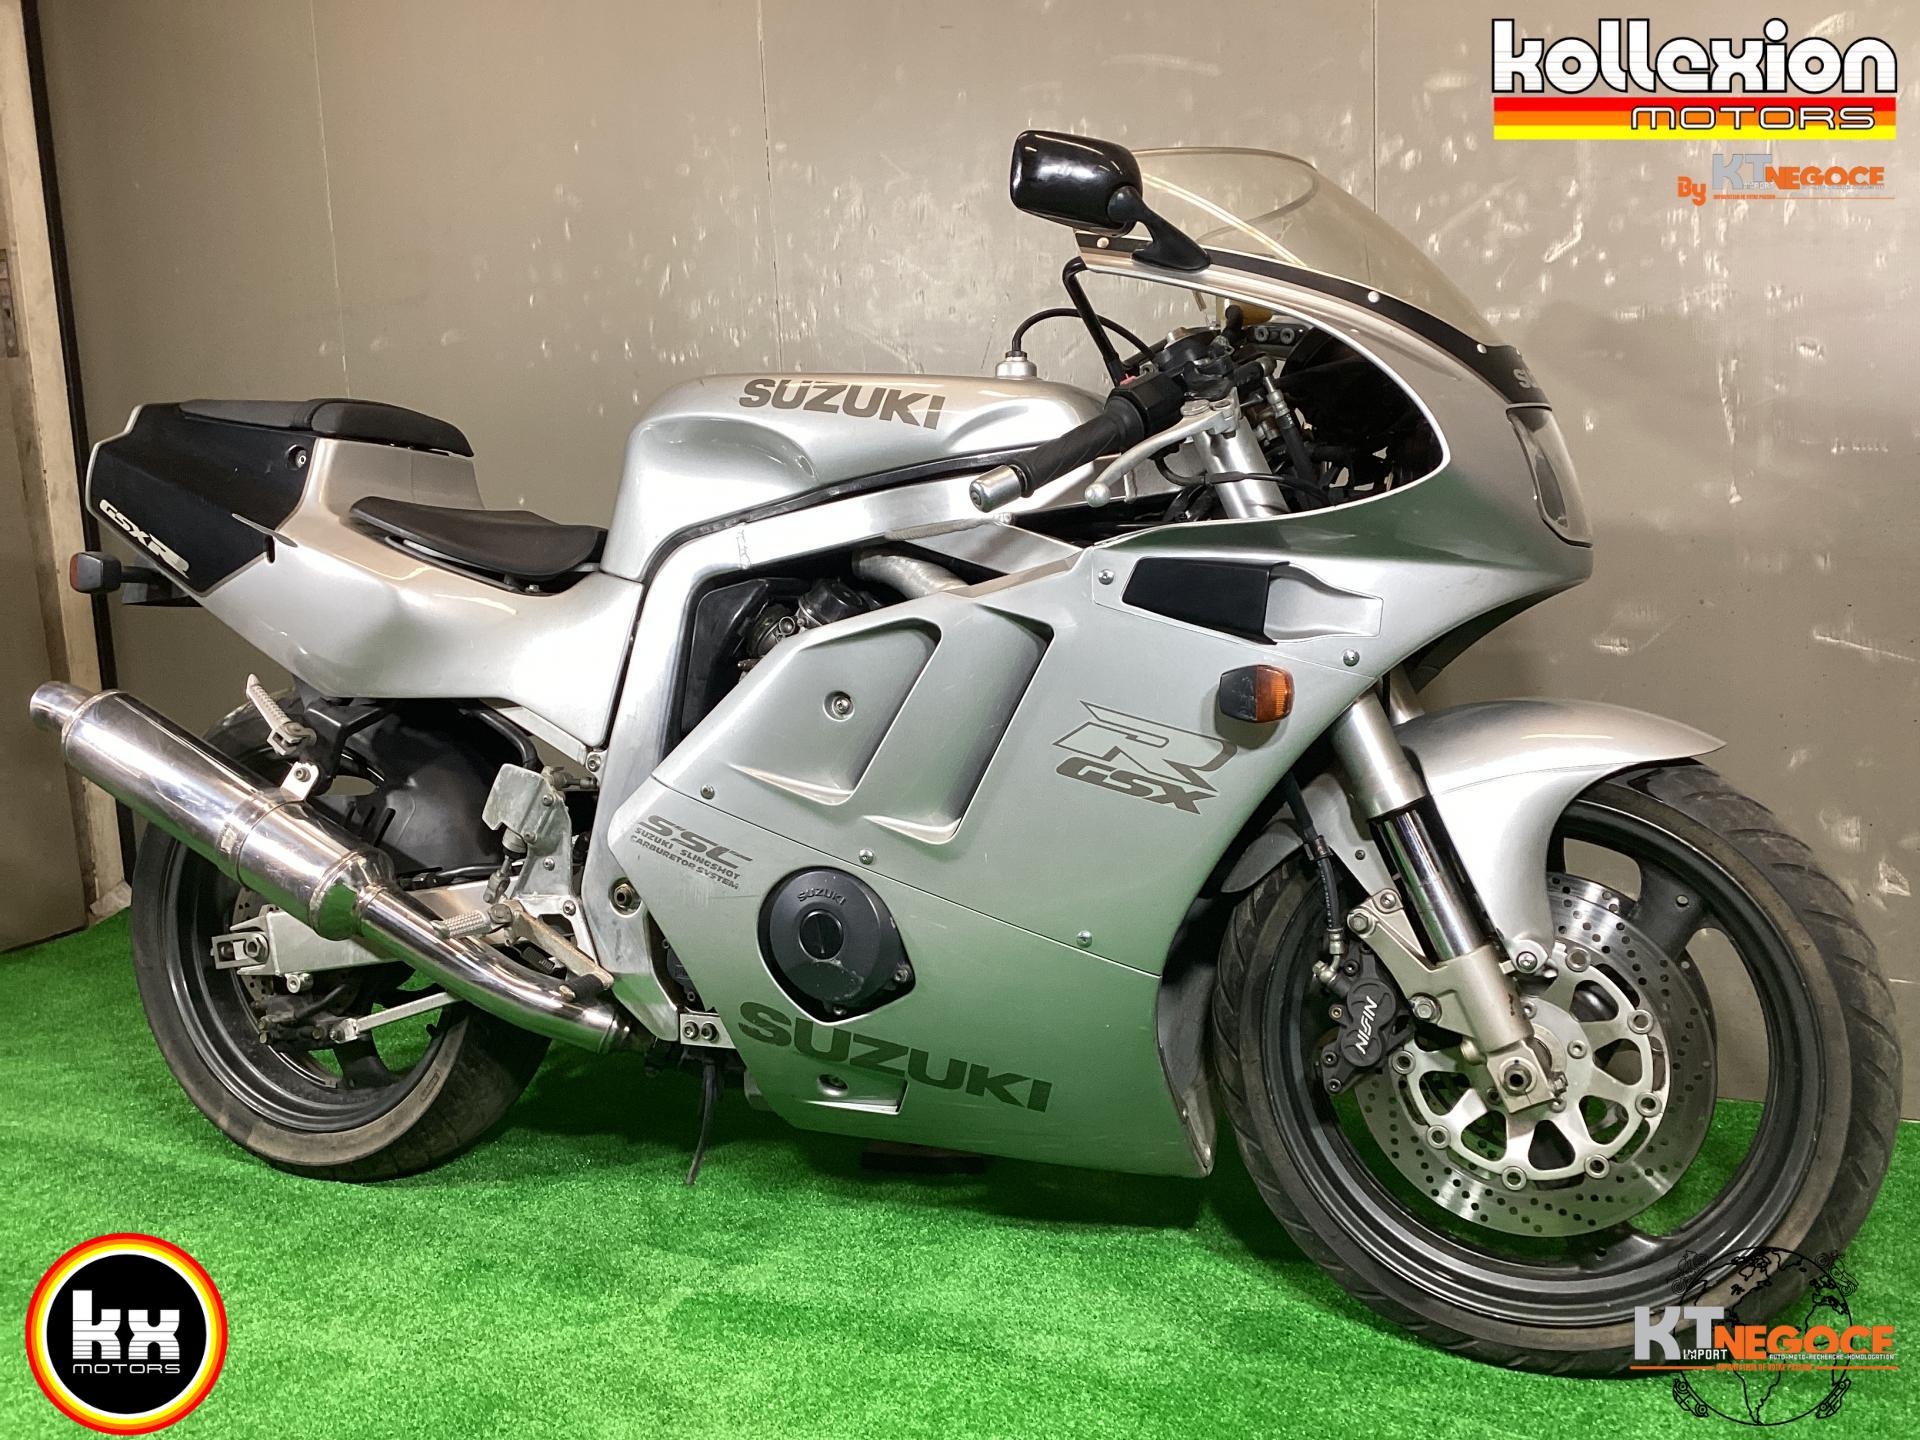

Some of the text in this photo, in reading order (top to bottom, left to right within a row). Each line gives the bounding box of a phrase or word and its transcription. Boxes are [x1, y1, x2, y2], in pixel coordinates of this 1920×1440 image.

[739, 378, 946, 431] SUZUKI
[1056, 756, 1216, 815] GSX
[630, 834, 740, 890] CARBURETOR SYSTEM
[635, 827, 741, 880] SUZUKI SLINGSHOT
[638, 815, 753, 869] SSC
[797, 887, 847, 906] SUZUKI
[739, 1001, 1053, 1113] SUZUKI
